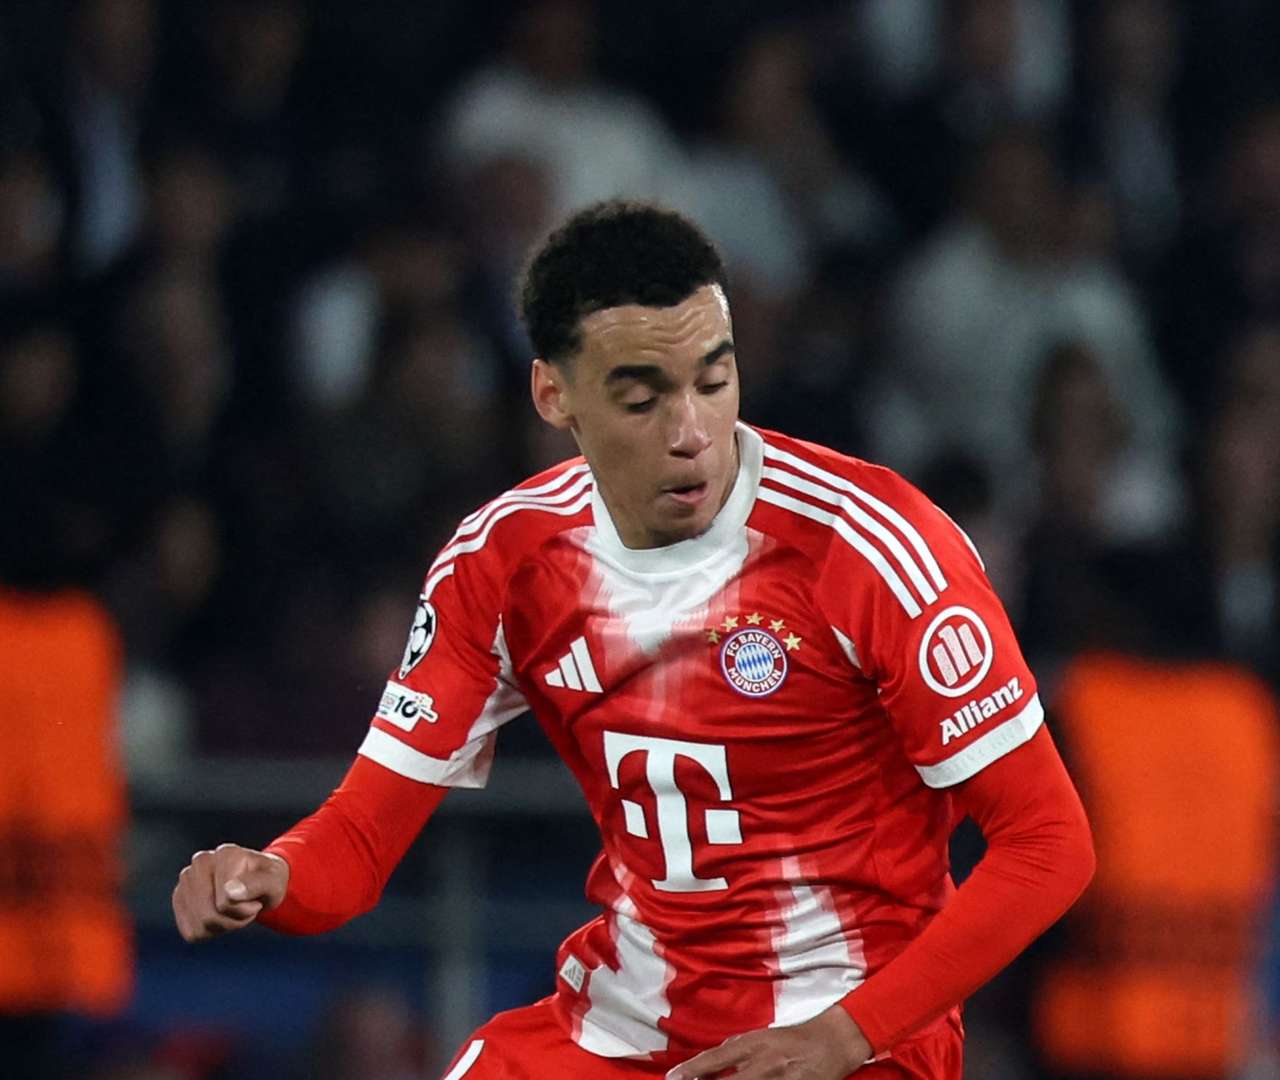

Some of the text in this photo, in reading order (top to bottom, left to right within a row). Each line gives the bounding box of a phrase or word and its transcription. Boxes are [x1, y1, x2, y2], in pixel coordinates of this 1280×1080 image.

[726, 633, 782, 659] FC BAYERN
[939, 676, 1024, 746] Allianz
[603, 730, 743, 892] T
